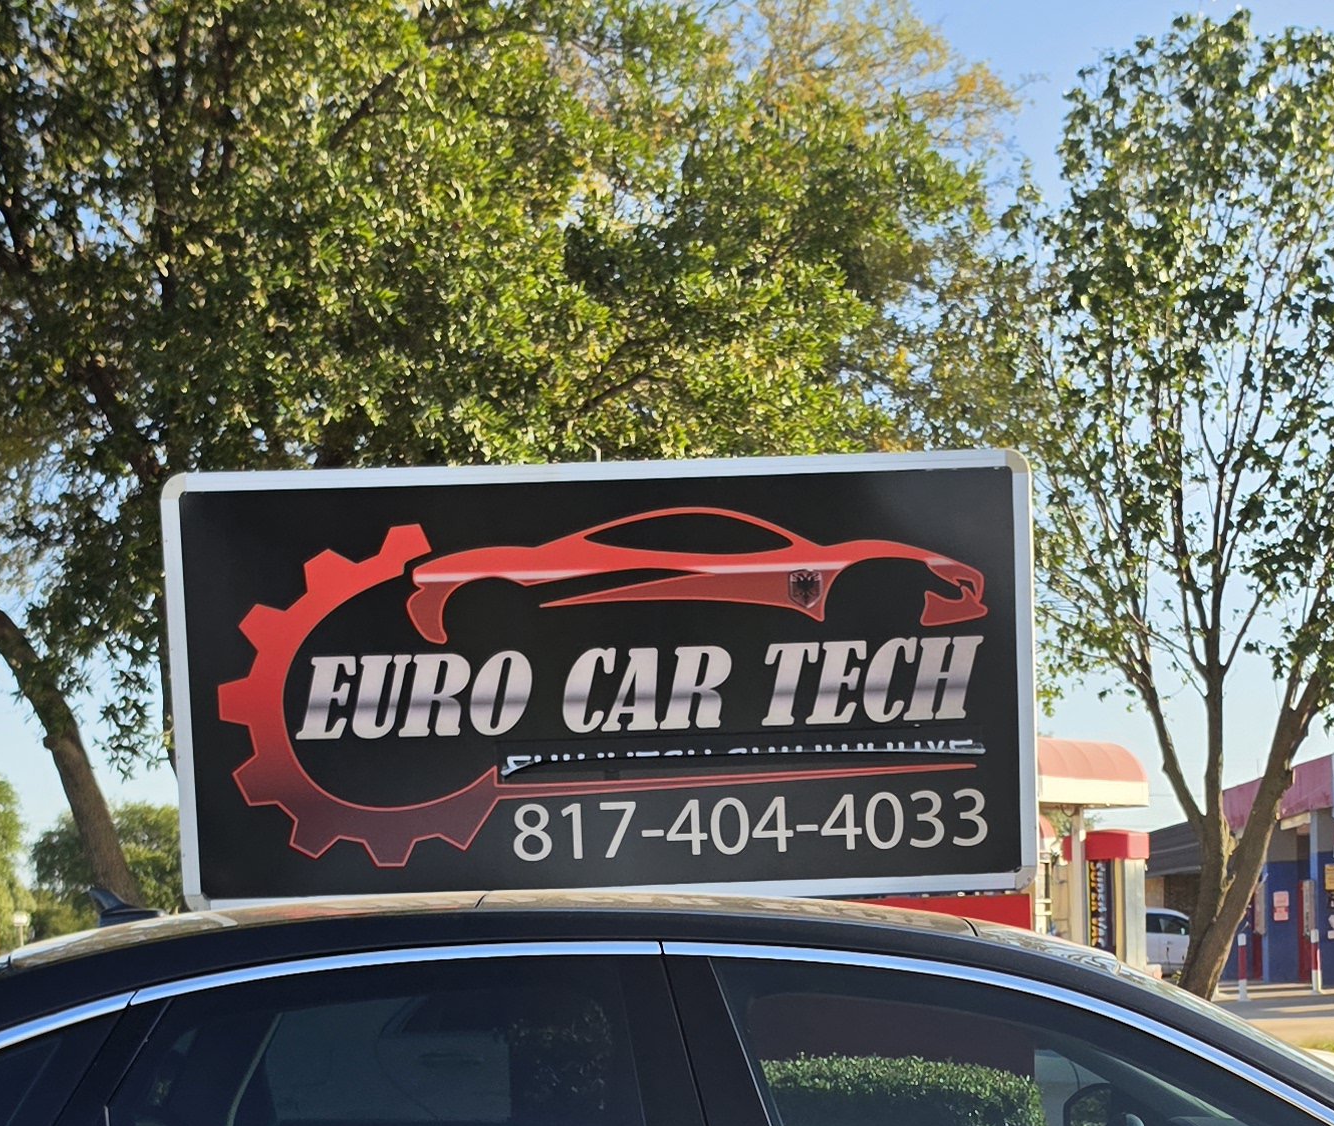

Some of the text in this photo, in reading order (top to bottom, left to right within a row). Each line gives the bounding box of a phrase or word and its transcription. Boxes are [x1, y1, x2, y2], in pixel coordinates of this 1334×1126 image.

[295, 635, 984, 740] EURO CAR TECH
[512, 788, 989, 862] 817-404-4033
[1090, 861, 1107, 947] SUPER VAC
